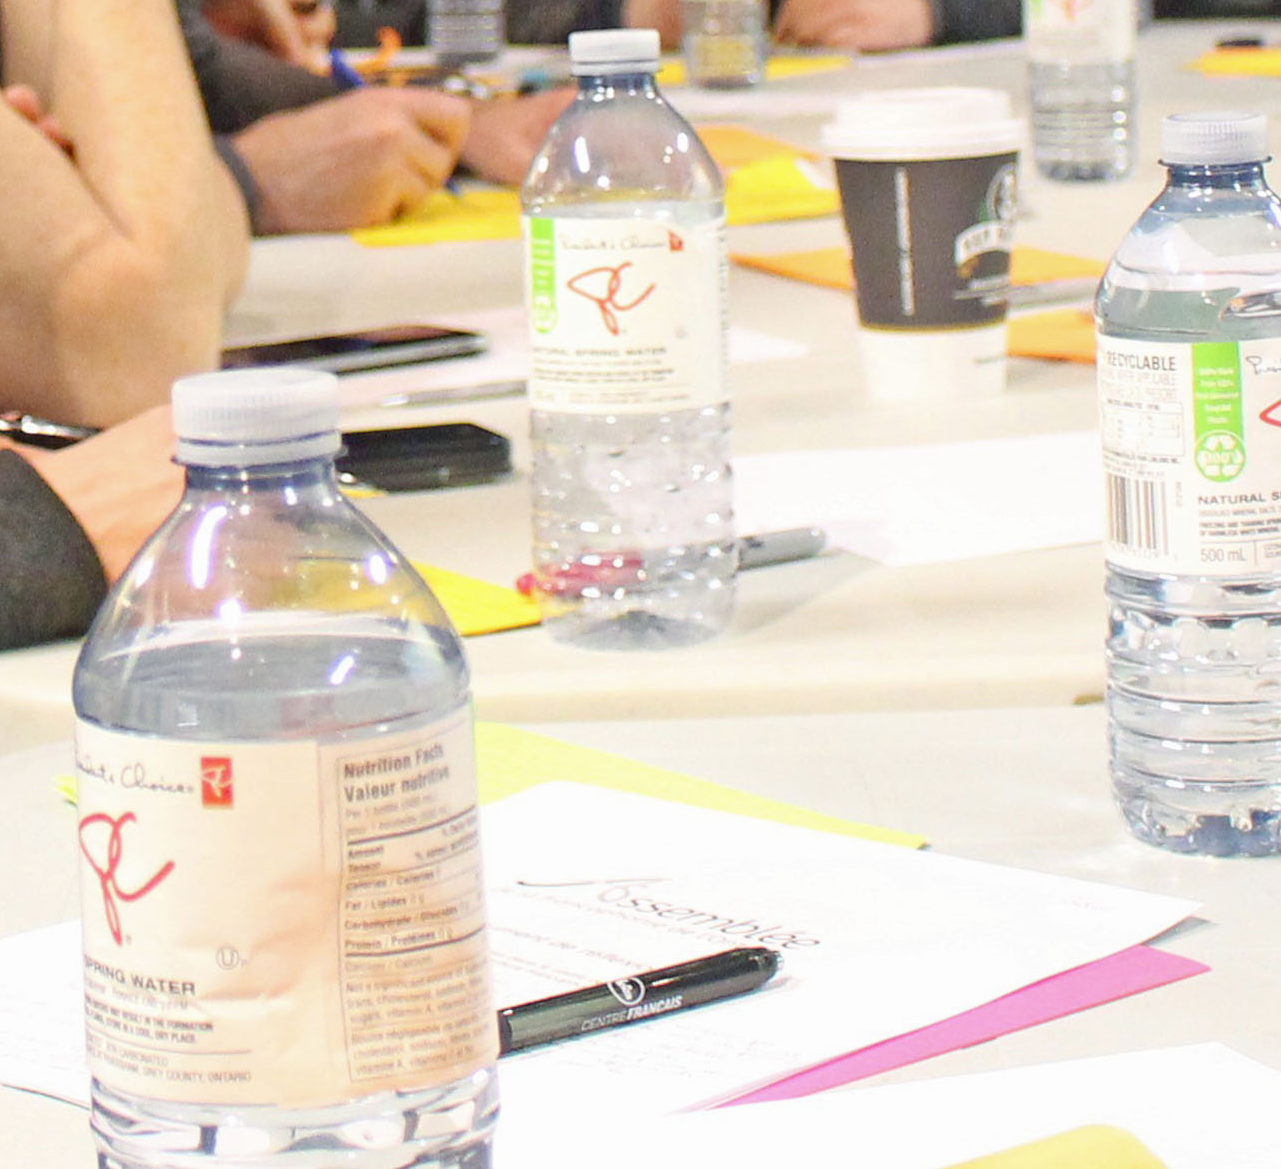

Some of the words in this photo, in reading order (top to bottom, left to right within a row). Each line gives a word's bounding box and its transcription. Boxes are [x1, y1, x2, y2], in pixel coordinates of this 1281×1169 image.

[1197, 492, 1267, 506] NATURAL
[1200, 548, 1225, 562] 500
[344, 754, 412, 779] Nutrition
[415, 743, 444, 765] Facts
[344, 781, 396, 803] Valeur
[131, 972, 196, 996] WATER
